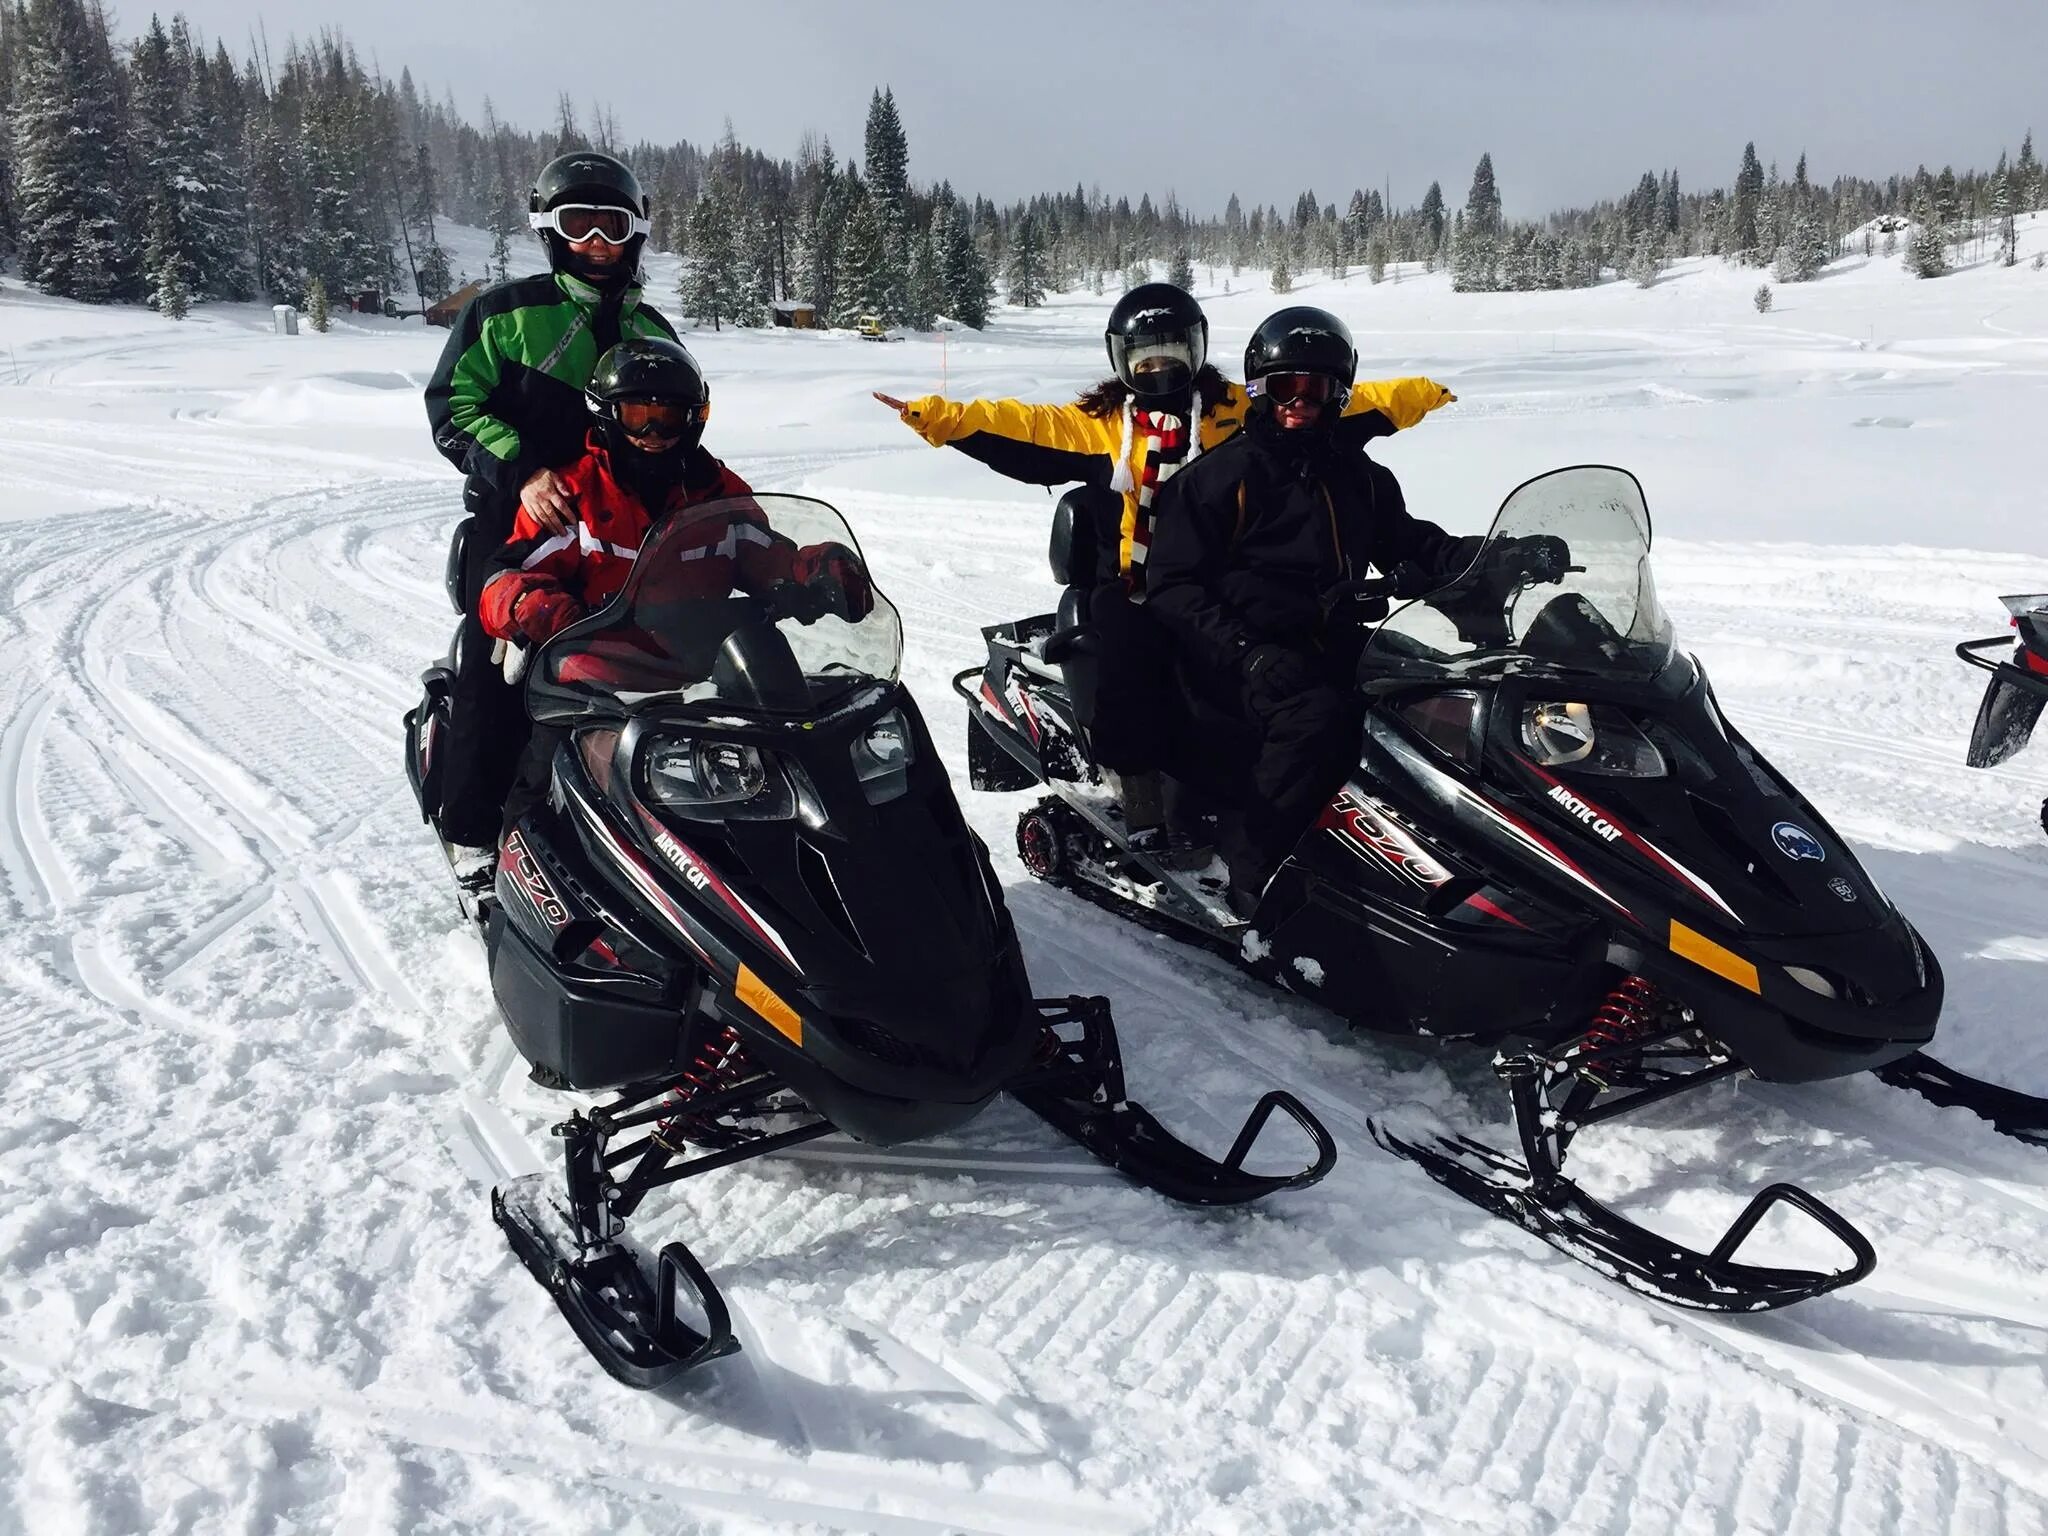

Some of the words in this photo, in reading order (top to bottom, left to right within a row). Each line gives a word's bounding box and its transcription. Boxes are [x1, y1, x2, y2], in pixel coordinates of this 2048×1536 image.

[1332, 791, 1446, 883] T570
[1547, 785, 1598, 824] ARCTIC
[1592, 818, 1623, 842] CAT
[507, 830, 569, 925] T570
[654, 831, 692, 872] ARCTIC
[686, 866, 711, 890] CAT
[1835, 885, 1851, 896] 50
